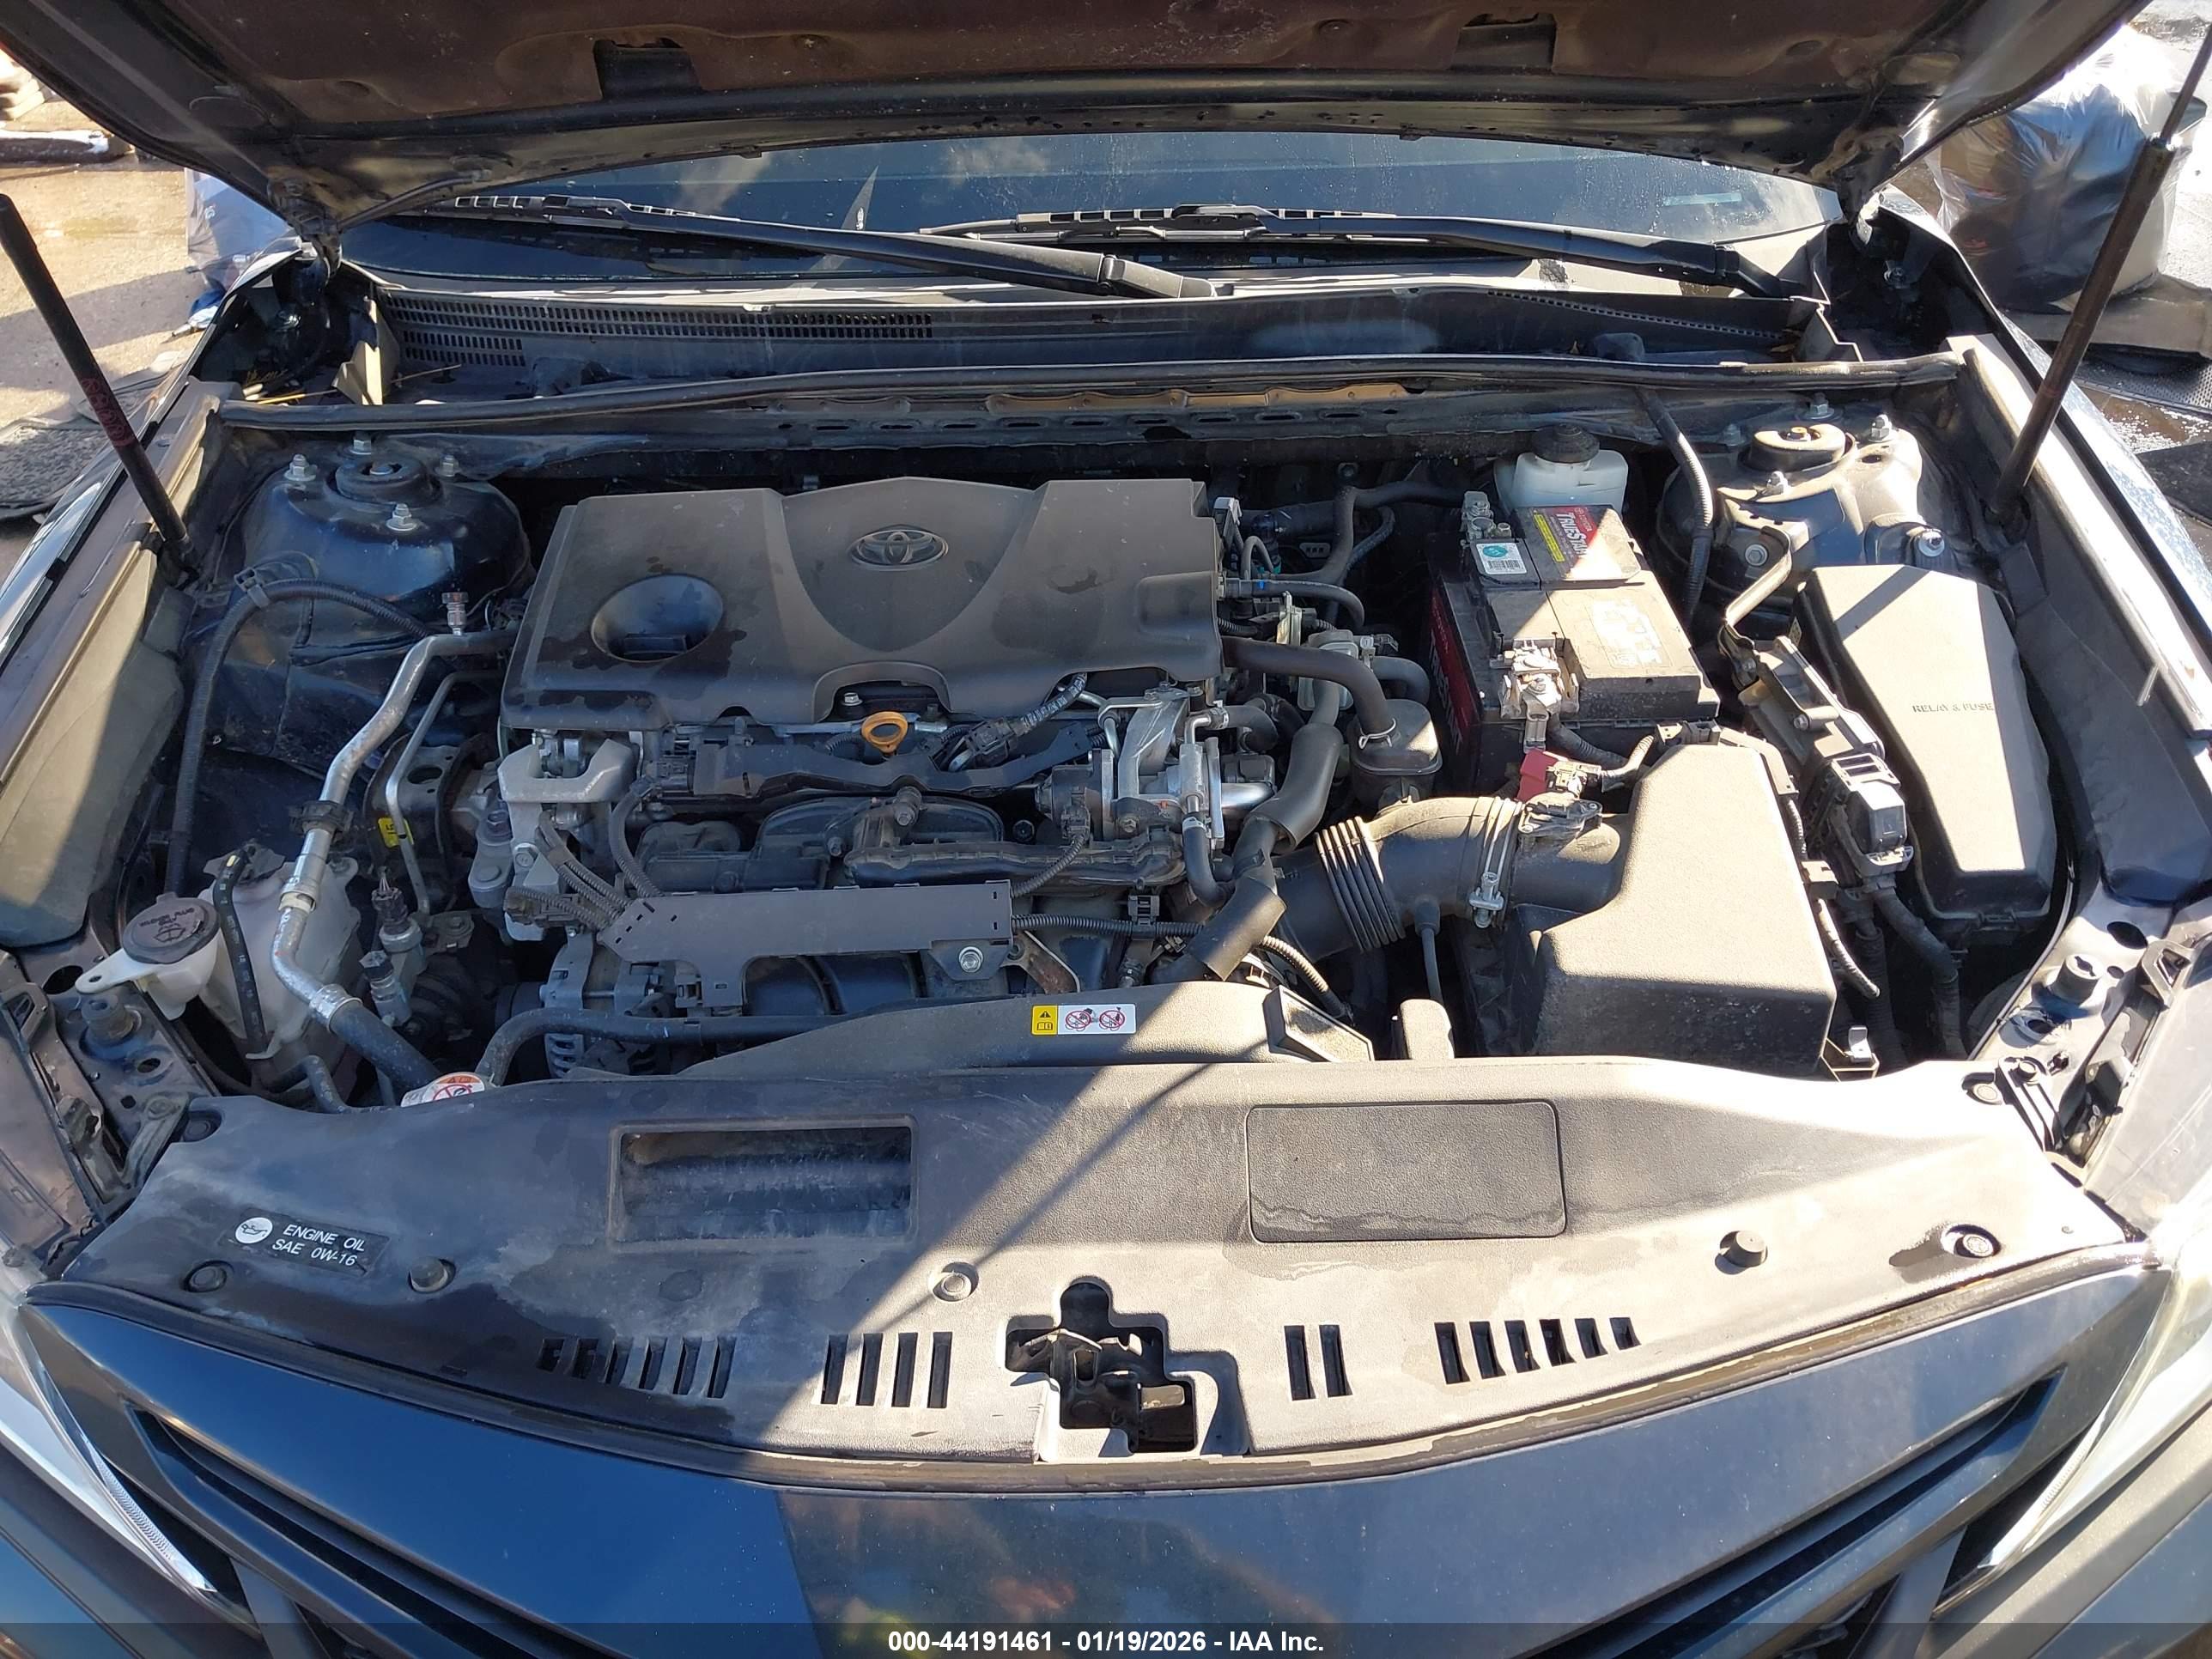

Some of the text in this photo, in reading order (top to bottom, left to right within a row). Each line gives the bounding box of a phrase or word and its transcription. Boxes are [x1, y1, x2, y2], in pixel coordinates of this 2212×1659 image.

[1911, 702, 1995, 713] RELAY & FUSE
[283, 1224, 366, 1252] ENGINE OIL
[272, 1238, 358, 1267] SAE 0W-16
